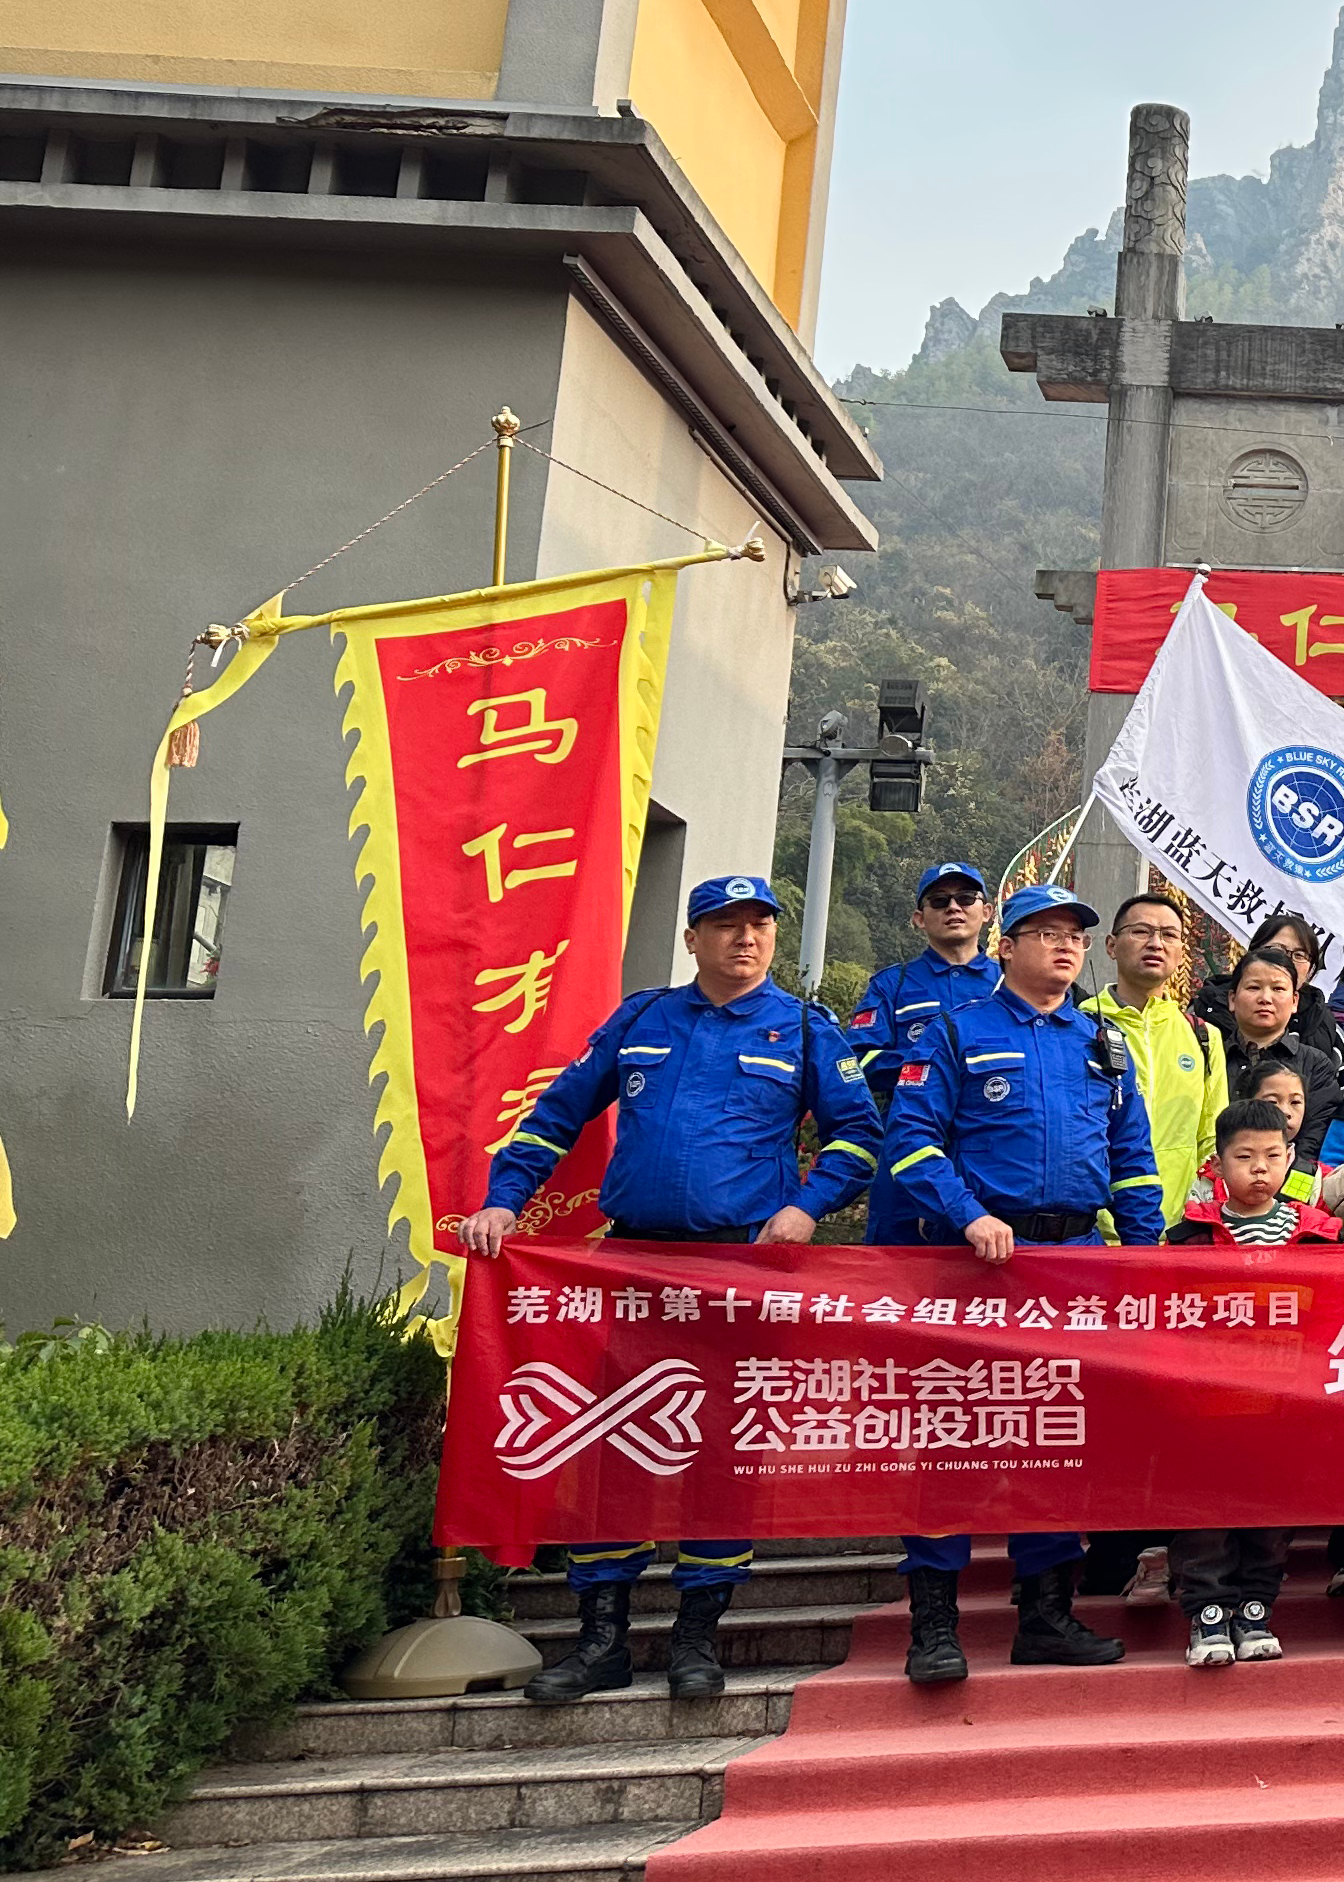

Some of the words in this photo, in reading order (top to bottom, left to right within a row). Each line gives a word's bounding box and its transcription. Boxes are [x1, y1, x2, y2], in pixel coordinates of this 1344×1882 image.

[1285, 751, 1314, 763] BLUE
[1315, 754, 1338, 771] SKY
[1271, 783, 1344, 847] BSR
[506, 1285, 1301, 1331] 芜湖市第十届社会组织公益创投项目
[733, 1356, 1082, 1405] 芜湖社会组织
[730, 1405, 1087, 1453] 公益创投项目
[734, 1465, 754, 1475] WU
[758, 1465, 776, 1474] HU
[780, 1464, 804, 1474] SHE
[808, 1463, 830, 1473] HUI
[834, 1463, 851, 1473] ZU
[855, 1462, 876, 1472] ZHI
[880, 1461, 916, 1472] GONG
[920, 1461, 933, 1471] YI
[936, 1460, 989, 1471] CHUANG
[992, 1460, 1018, 1469] TOU
[1021, 1459, 1060, 1469] XIANG
[1063, 1458, 1083, 1468] MU
